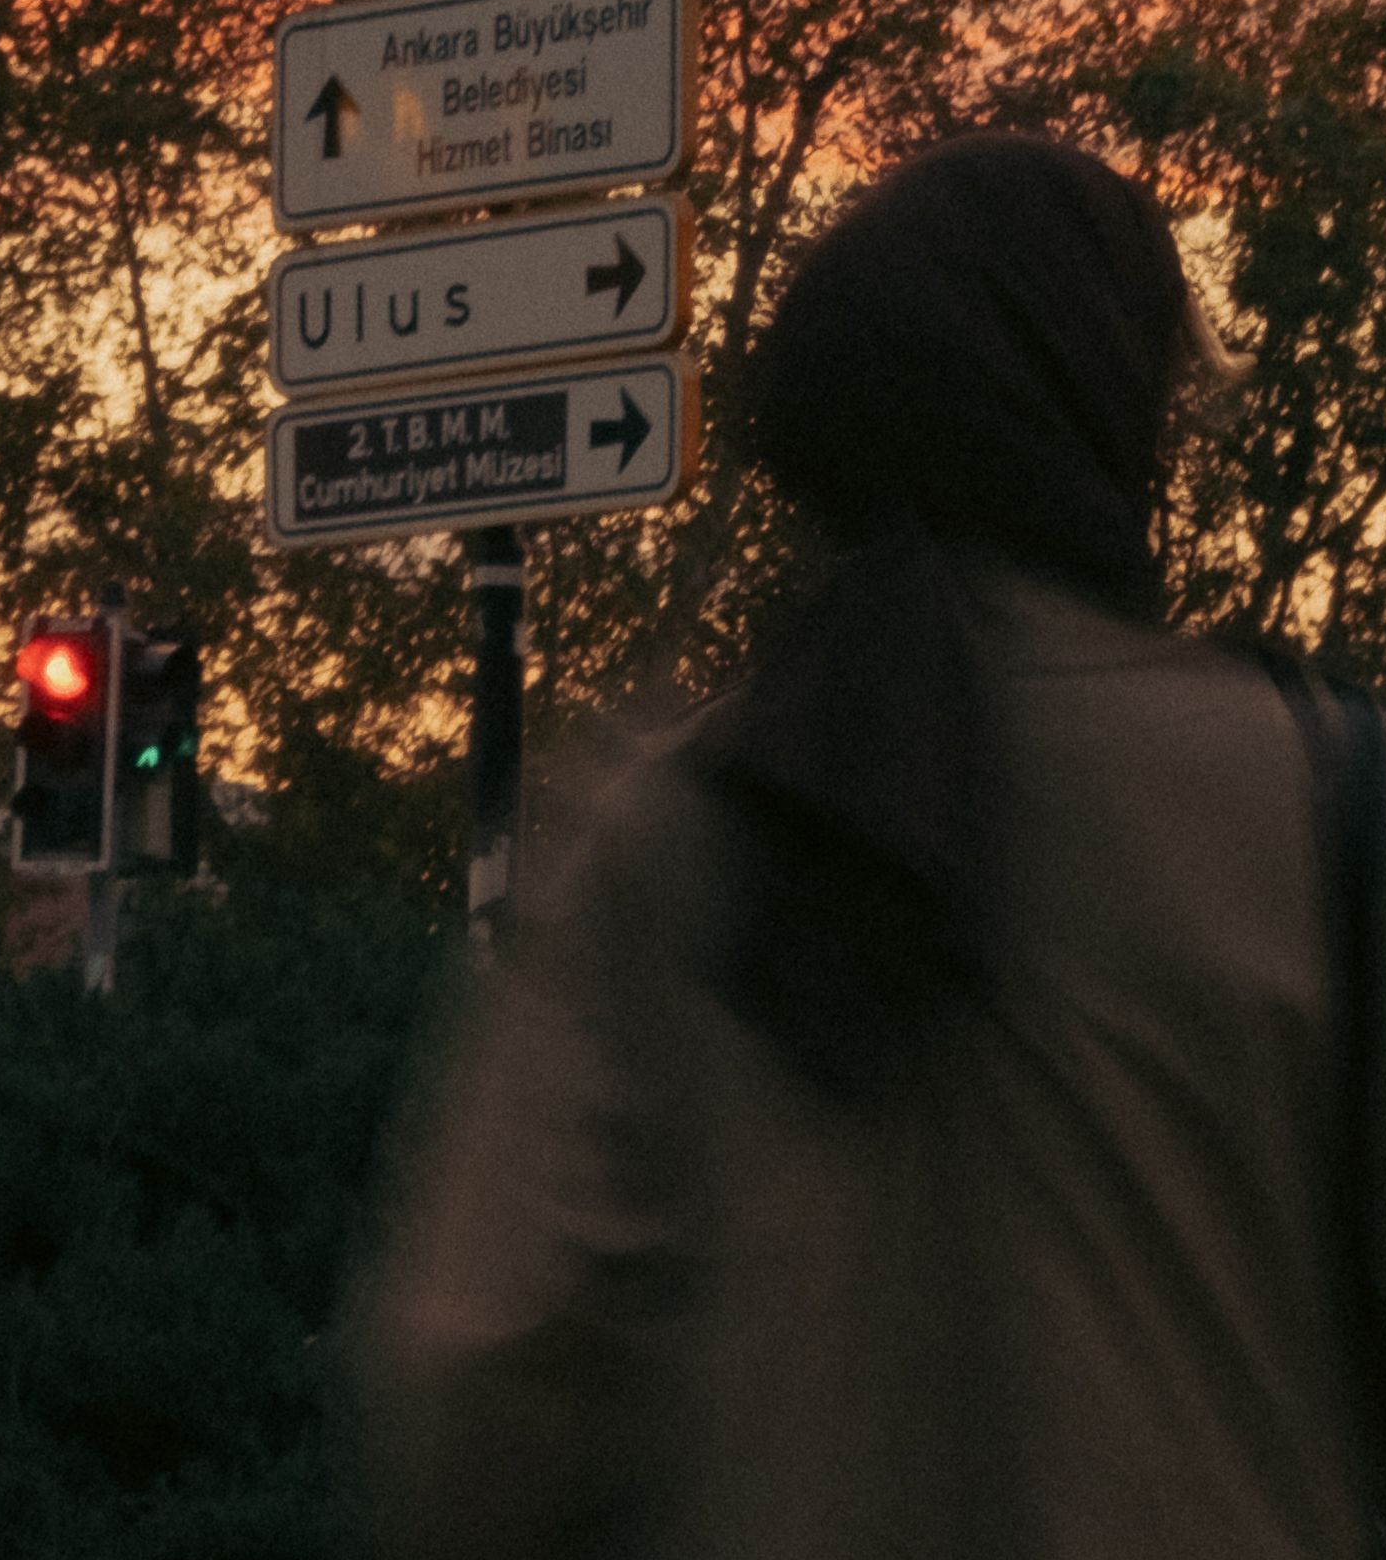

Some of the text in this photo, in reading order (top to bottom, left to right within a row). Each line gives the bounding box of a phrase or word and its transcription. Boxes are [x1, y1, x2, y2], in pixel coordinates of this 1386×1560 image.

[380, 27, 478, 71] Ankara
[441, 57, 588, 113] Belediyesi
[417, 118, 613, 177] Hizmet Binası
[298, 283, 472, 350] Ulus
[297, 442, 564, 510] Cumhuriyet Müzesi
